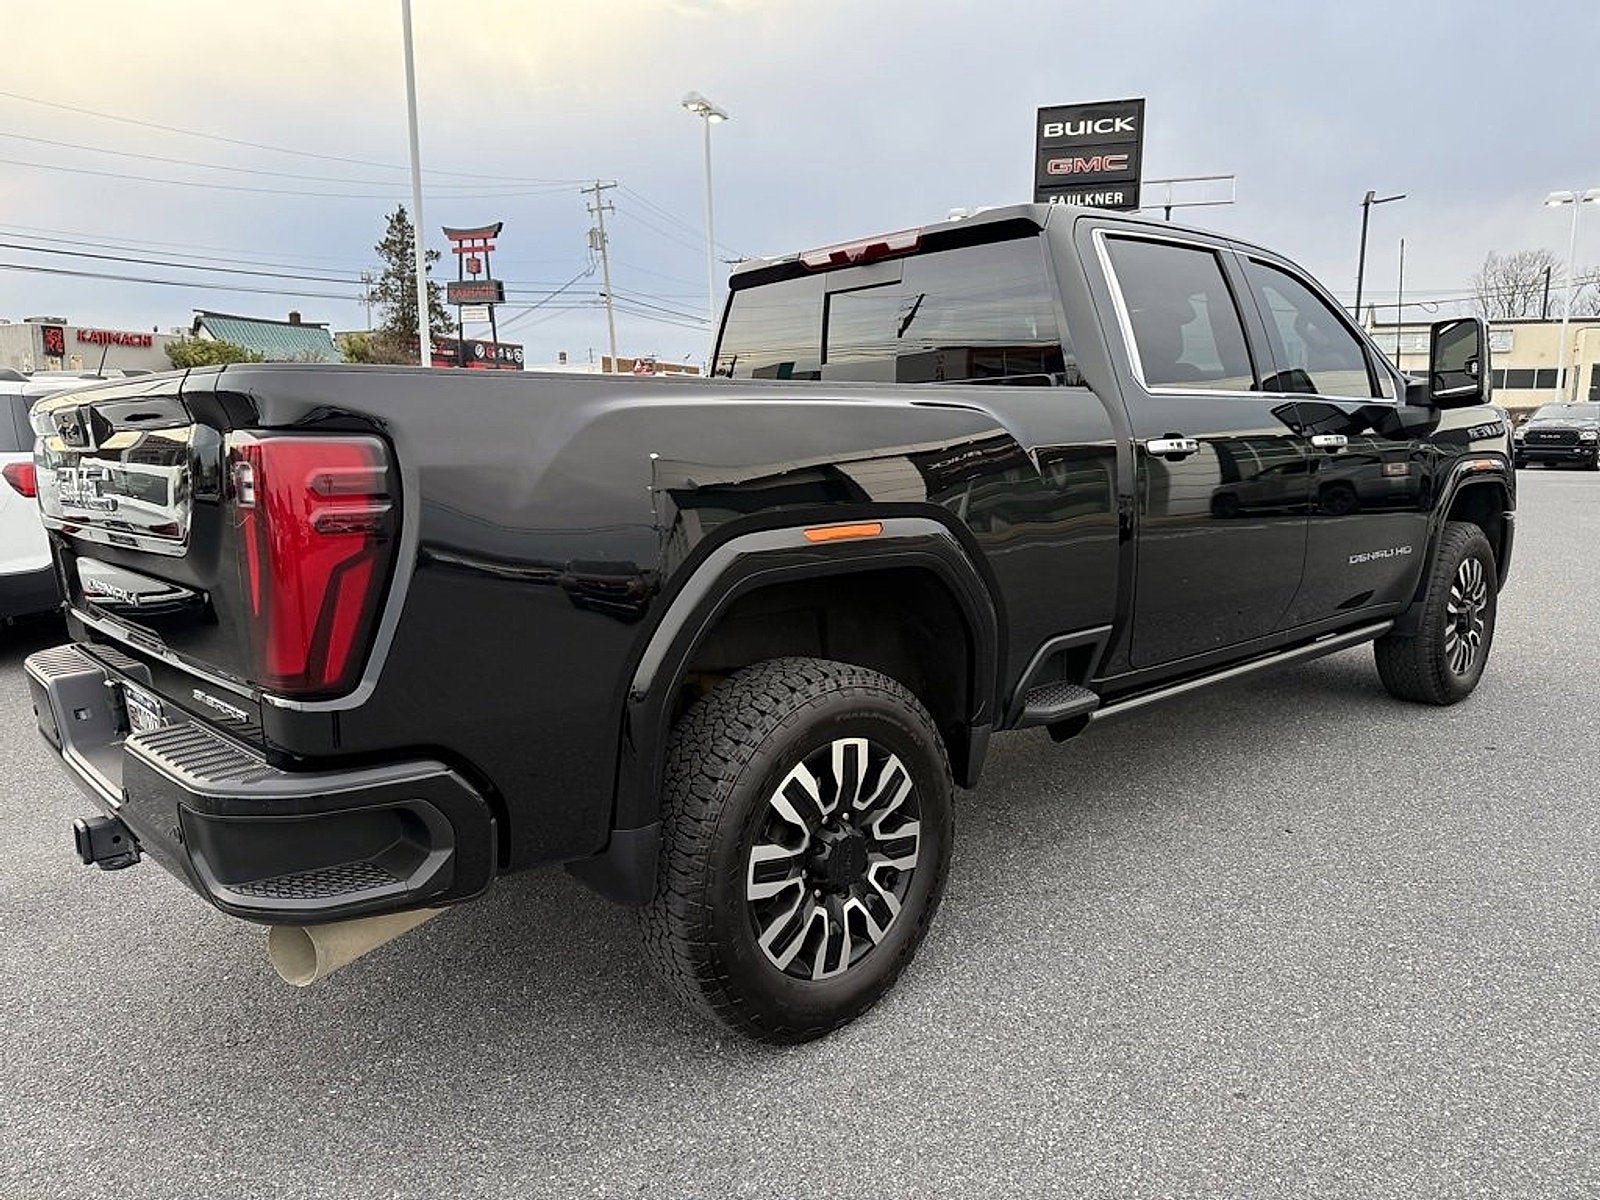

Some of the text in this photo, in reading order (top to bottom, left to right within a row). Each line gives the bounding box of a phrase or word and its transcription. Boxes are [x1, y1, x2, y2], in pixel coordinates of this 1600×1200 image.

[1043, 117, 1135, 138] BUICK
[1047, 154, 1128, 175] GMC
[1049, 191, 1124, 206] FAULKNER
[1395, 545, 1413, 556] HD
